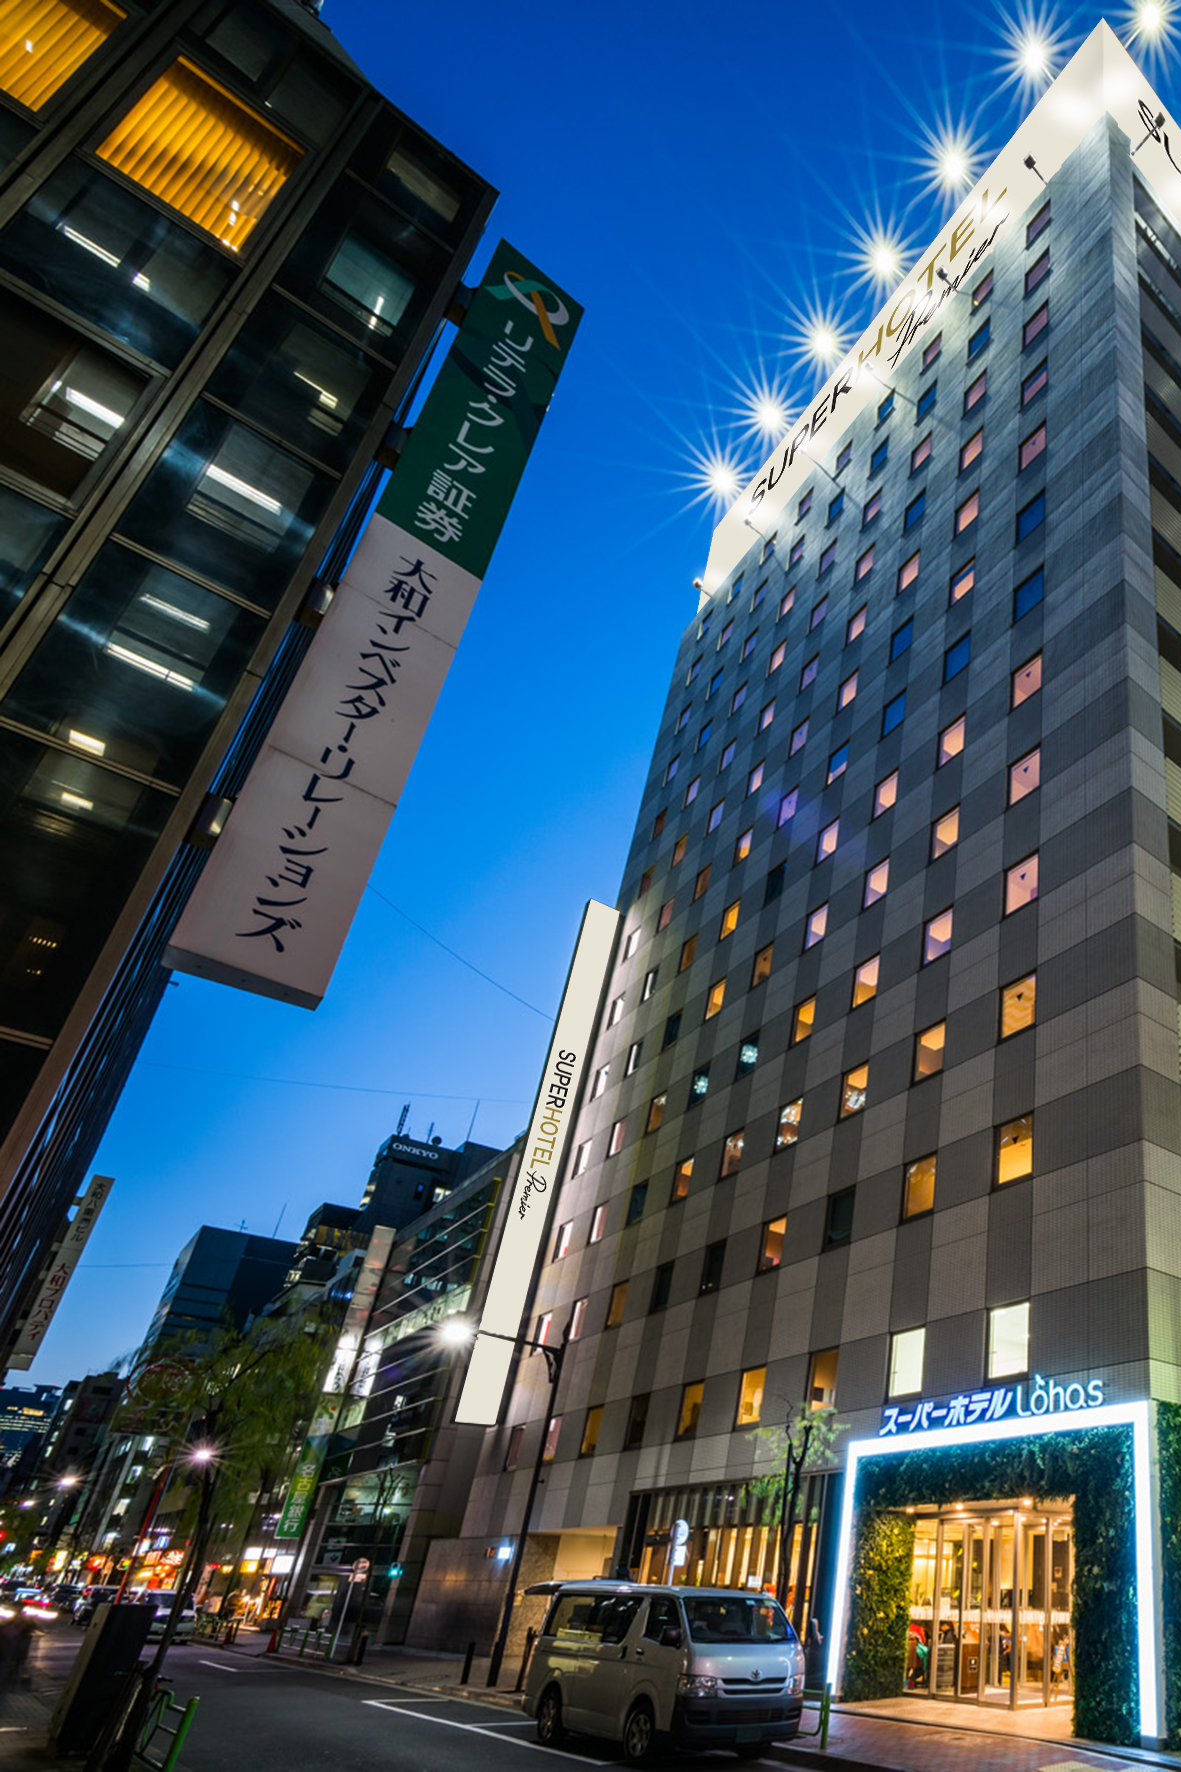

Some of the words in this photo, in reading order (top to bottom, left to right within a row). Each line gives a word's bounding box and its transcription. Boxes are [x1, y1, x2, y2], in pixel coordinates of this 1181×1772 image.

[234, 555, 439, 954] 大和インベスター・リレーションズ
[392, 1142, 439, 1160] ONKYO
[518, 1169, 548, 1220] Premier
[879, 1386, 1014, 1437] スーパーホテル
[283, 1464, 318, 1533] 名古屋銀行
